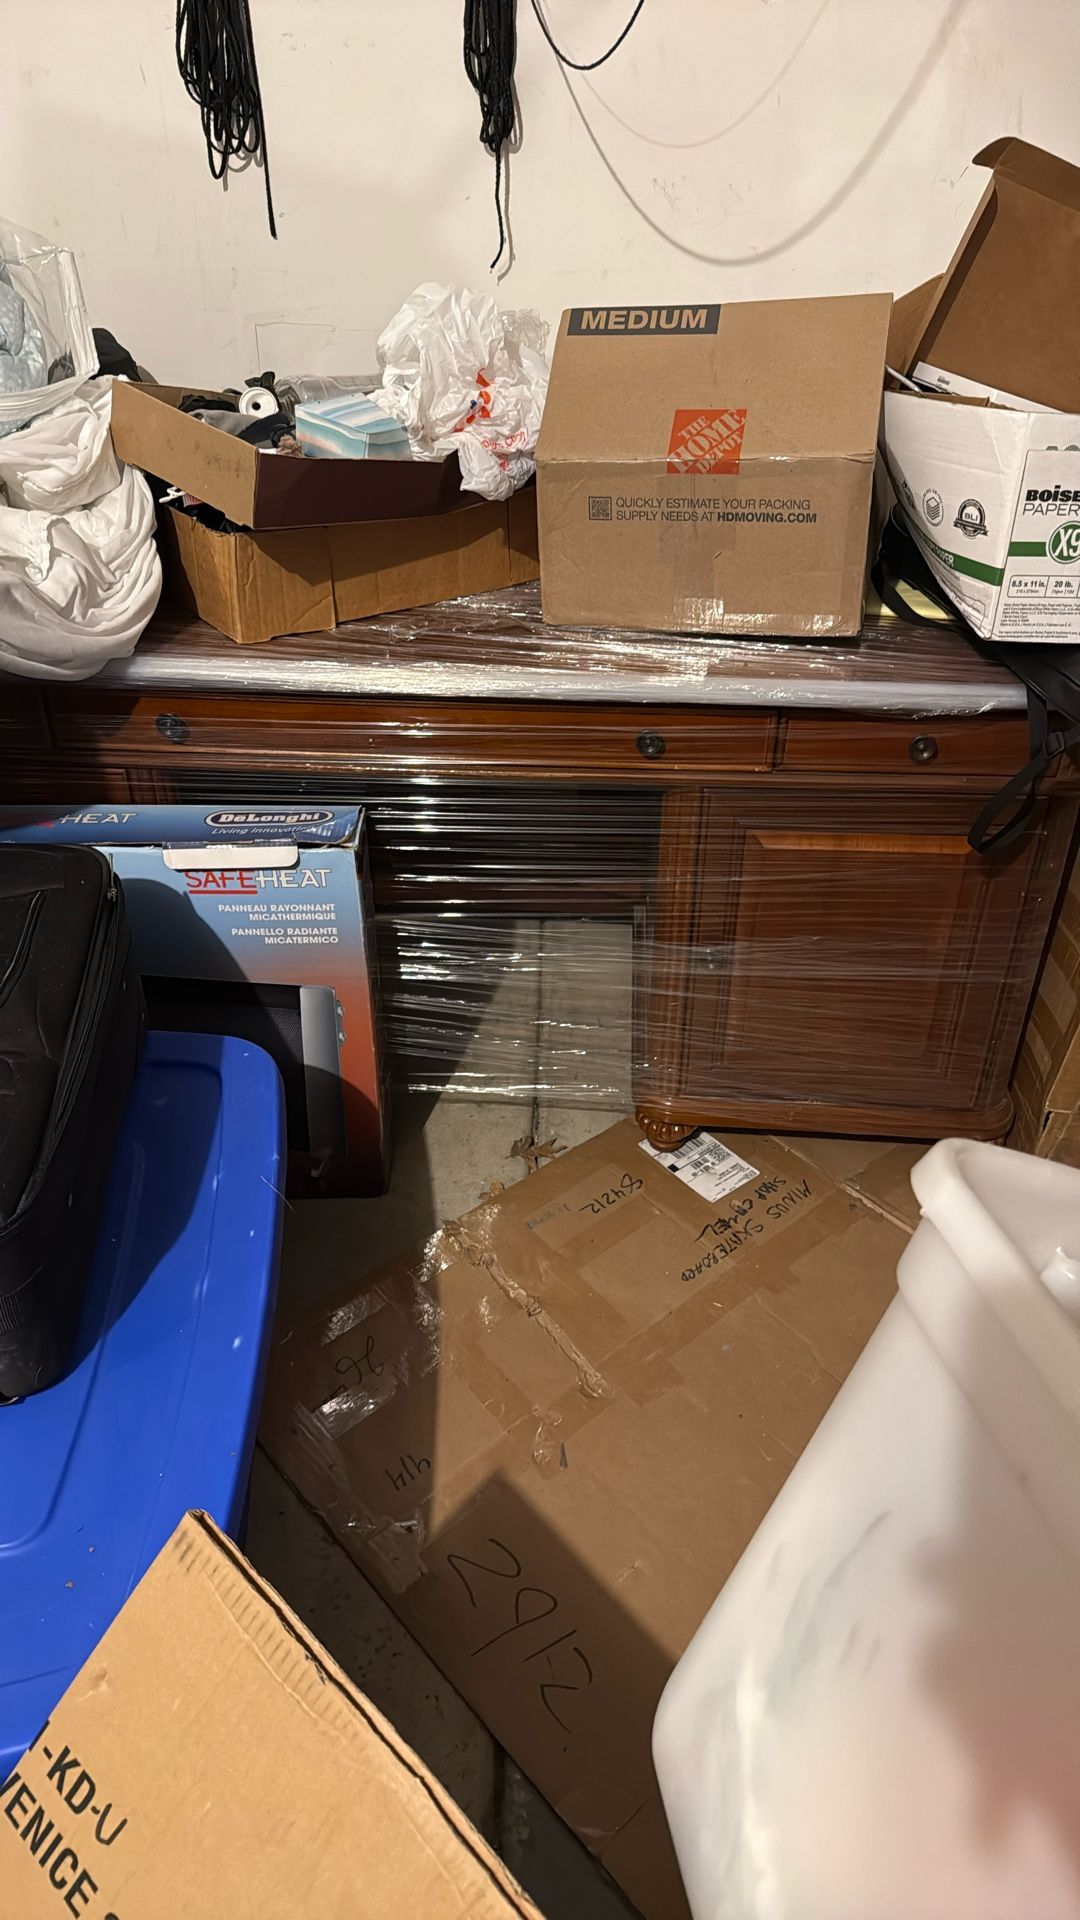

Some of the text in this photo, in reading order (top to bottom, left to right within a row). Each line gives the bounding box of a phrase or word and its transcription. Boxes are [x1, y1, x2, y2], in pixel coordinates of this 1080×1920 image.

[580, 309, 708, 330] MEDIUM
[678, 415, 711, 440] THE
[669, 409, 746, 473] HOME
[696, 432, 742, 474] DEPOT
[616, 497, 811, 511] QUICKLY ESTIMATE YOUR PACKING
[1022, 503, 1080, 516] PAPER
[616, 510, 818, 524] SUPPLY NEEDS AT HDMOVING.COM
[964, 512, 979, 522] BLI
[1011, 580, 1023, 588] 8.5
[1030, 580, 1038, 588] 11
[1053, 580, 1064, 588] 20
[212, 827, 248, 835] Living
[185, 869, 331, 889] SAFEHEAT
[218, 903, 336, 912] PANNEAU RAYONNANT
[249, 913, 337, 921] MICATHERMIQUE
[231, 927, 338, 936] PANNELLO RADIANTE
[265, 936, 339, 944] MICATERMICO
[681, 1179, 812, 1282] MINUS SKATEBOARD
